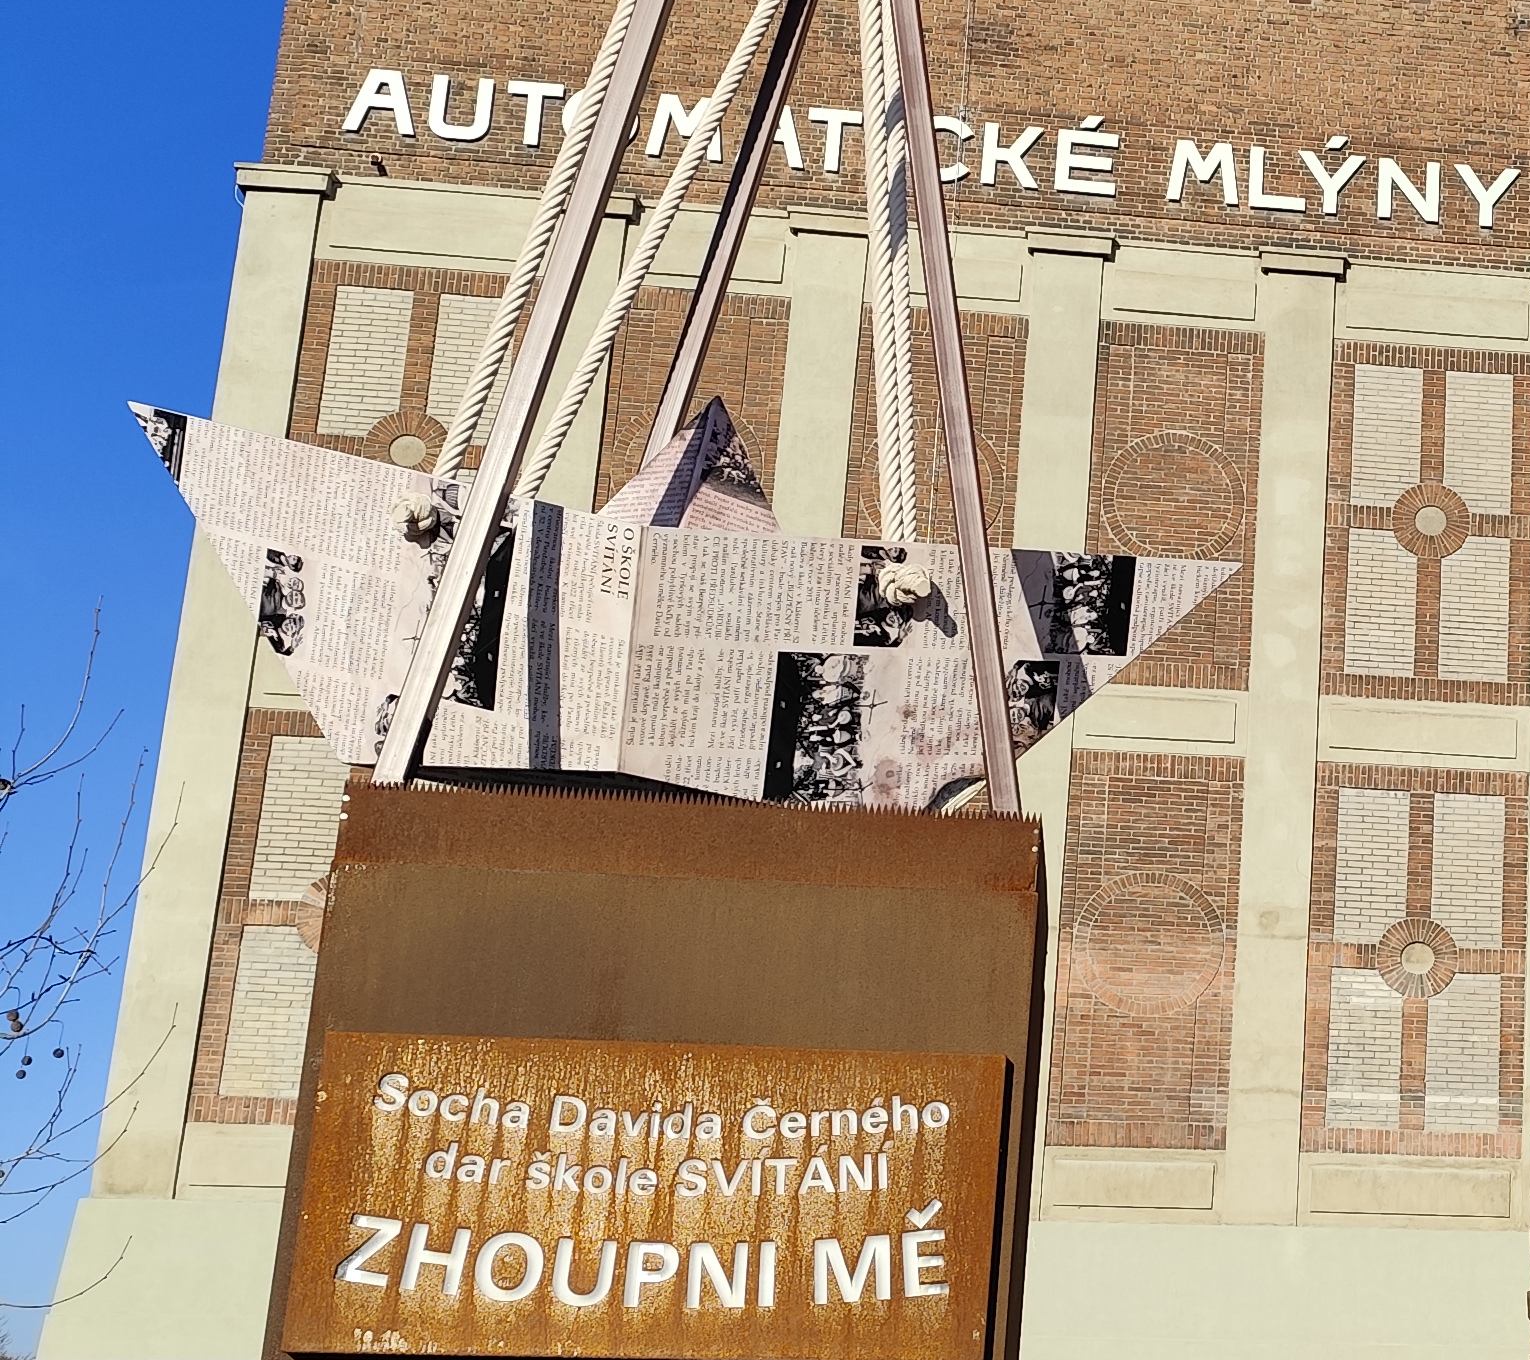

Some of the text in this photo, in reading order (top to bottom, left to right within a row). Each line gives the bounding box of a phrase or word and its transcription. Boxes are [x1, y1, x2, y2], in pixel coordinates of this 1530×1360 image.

[341, 66, 1522, 230] AUTMATCKÉ MLÝNY
[599, 522, 620, 595] SVÍTÁNÍ
[616, 526, 636, 600] O ŠKOLE
[373, 1072, 951, 1142] Socha Davida Černého
[424, 1140, 890, 1199] dar škole SVÍTÁNÍ
[334, 1198, 951, 1310] ZHOUPNI MĚ
